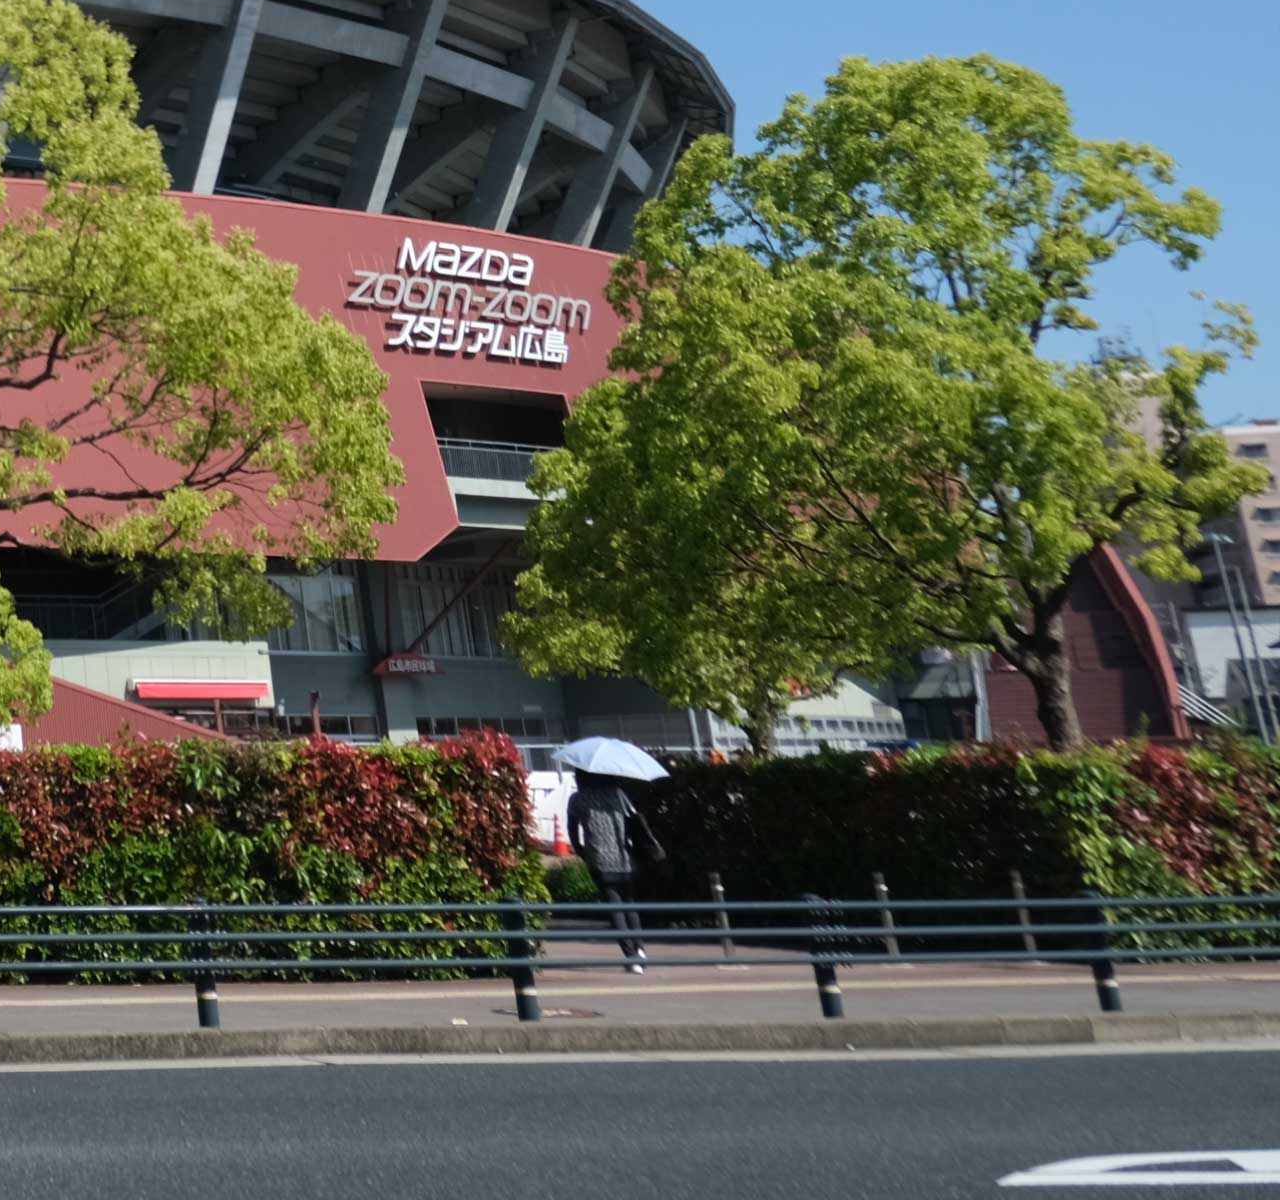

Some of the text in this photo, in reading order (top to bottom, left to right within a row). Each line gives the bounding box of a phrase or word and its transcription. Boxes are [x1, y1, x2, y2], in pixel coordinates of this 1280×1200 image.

[348, 270, 591, 330] zoom-zoom
[388, 313, 568, 363] スタジアム広島
